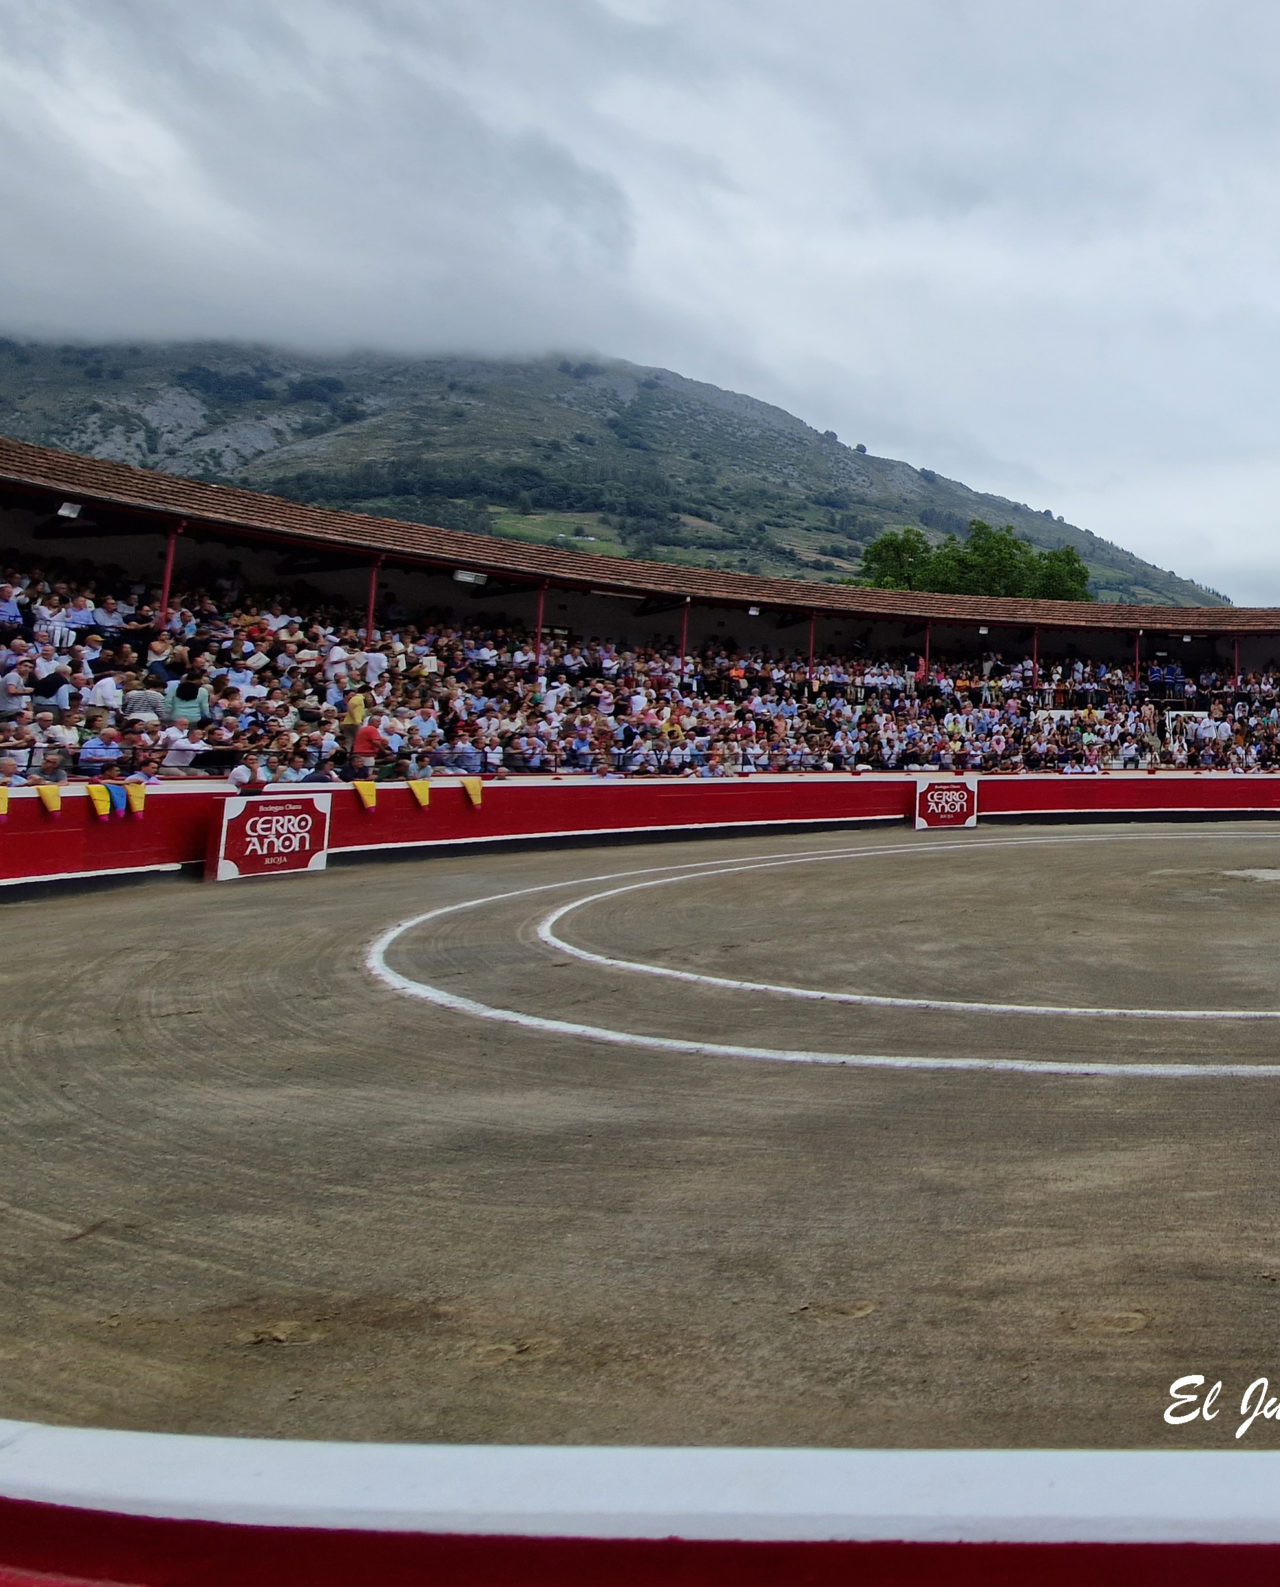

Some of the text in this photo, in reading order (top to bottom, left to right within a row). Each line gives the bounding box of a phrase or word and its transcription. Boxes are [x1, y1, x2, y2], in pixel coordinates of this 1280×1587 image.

[927, 791, 968, 802] CERRO
[245, 814, 312, 836] CERRO
[264, 856, 288, 865] RIOJA
